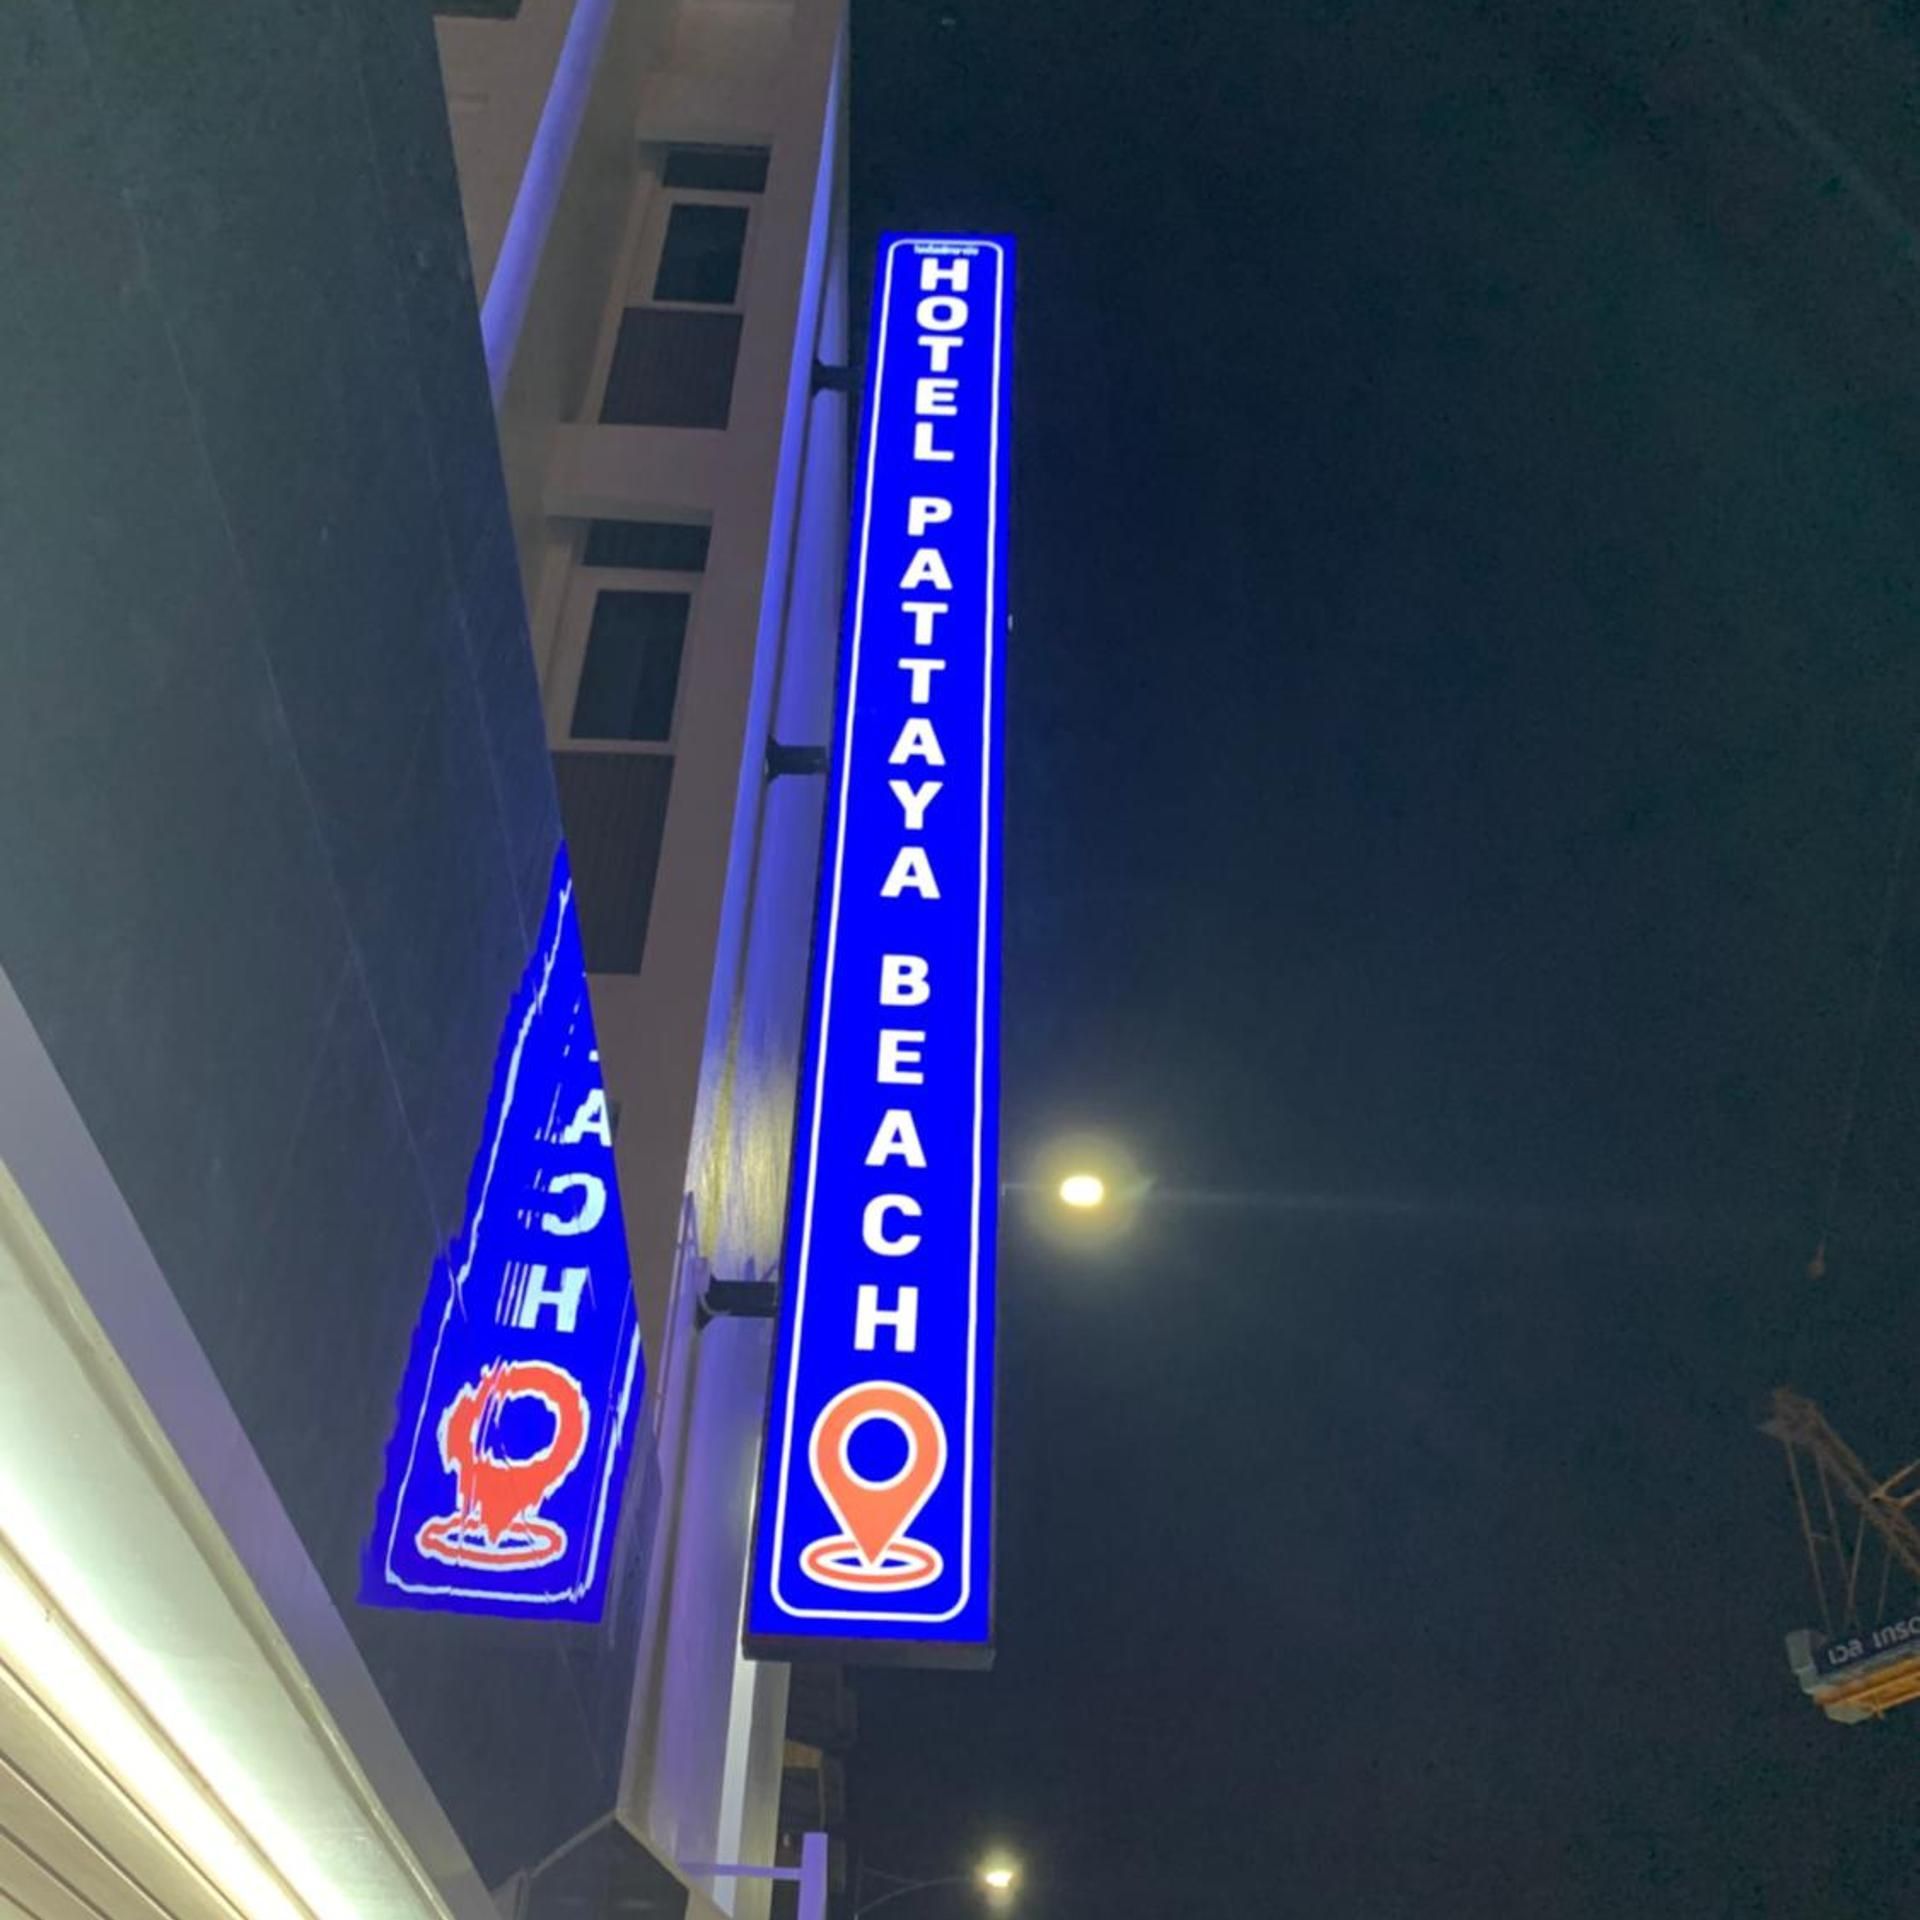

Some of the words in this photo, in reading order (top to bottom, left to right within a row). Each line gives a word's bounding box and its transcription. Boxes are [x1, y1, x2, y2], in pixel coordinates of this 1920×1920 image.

[914, 257, 970, 461] HOTEL
[880, 496, 953, 899] PATTAYA
[854, 954, 930, 1352] BEACH
